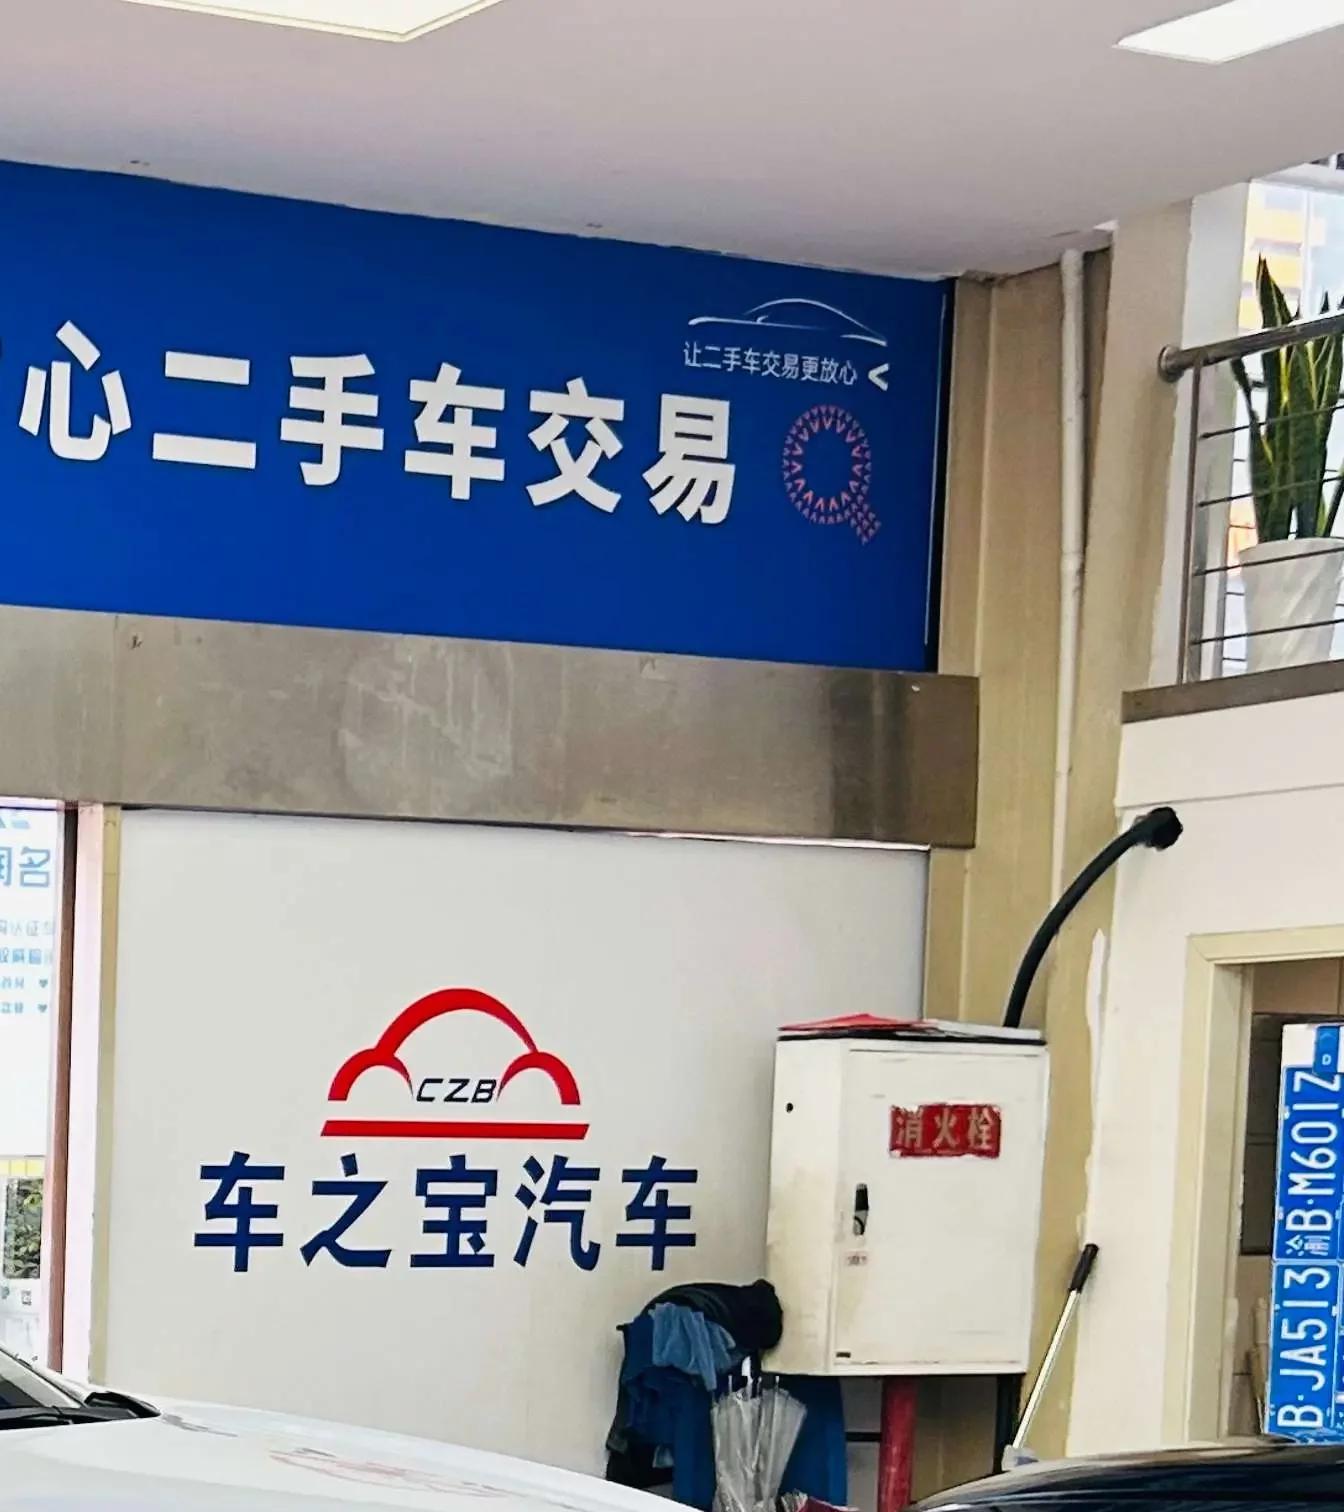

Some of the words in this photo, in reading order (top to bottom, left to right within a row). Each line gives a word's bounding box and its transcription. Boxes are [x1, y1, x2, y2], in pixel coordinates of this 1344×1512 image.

[683, 342, 858, 386] 让二手车交易更放心
[416, 1078, 497, 1104] CZB
[895, 1108, 996, 1150] 消火栓
[193, 1150, 699, 1273] 车之宝汽车
